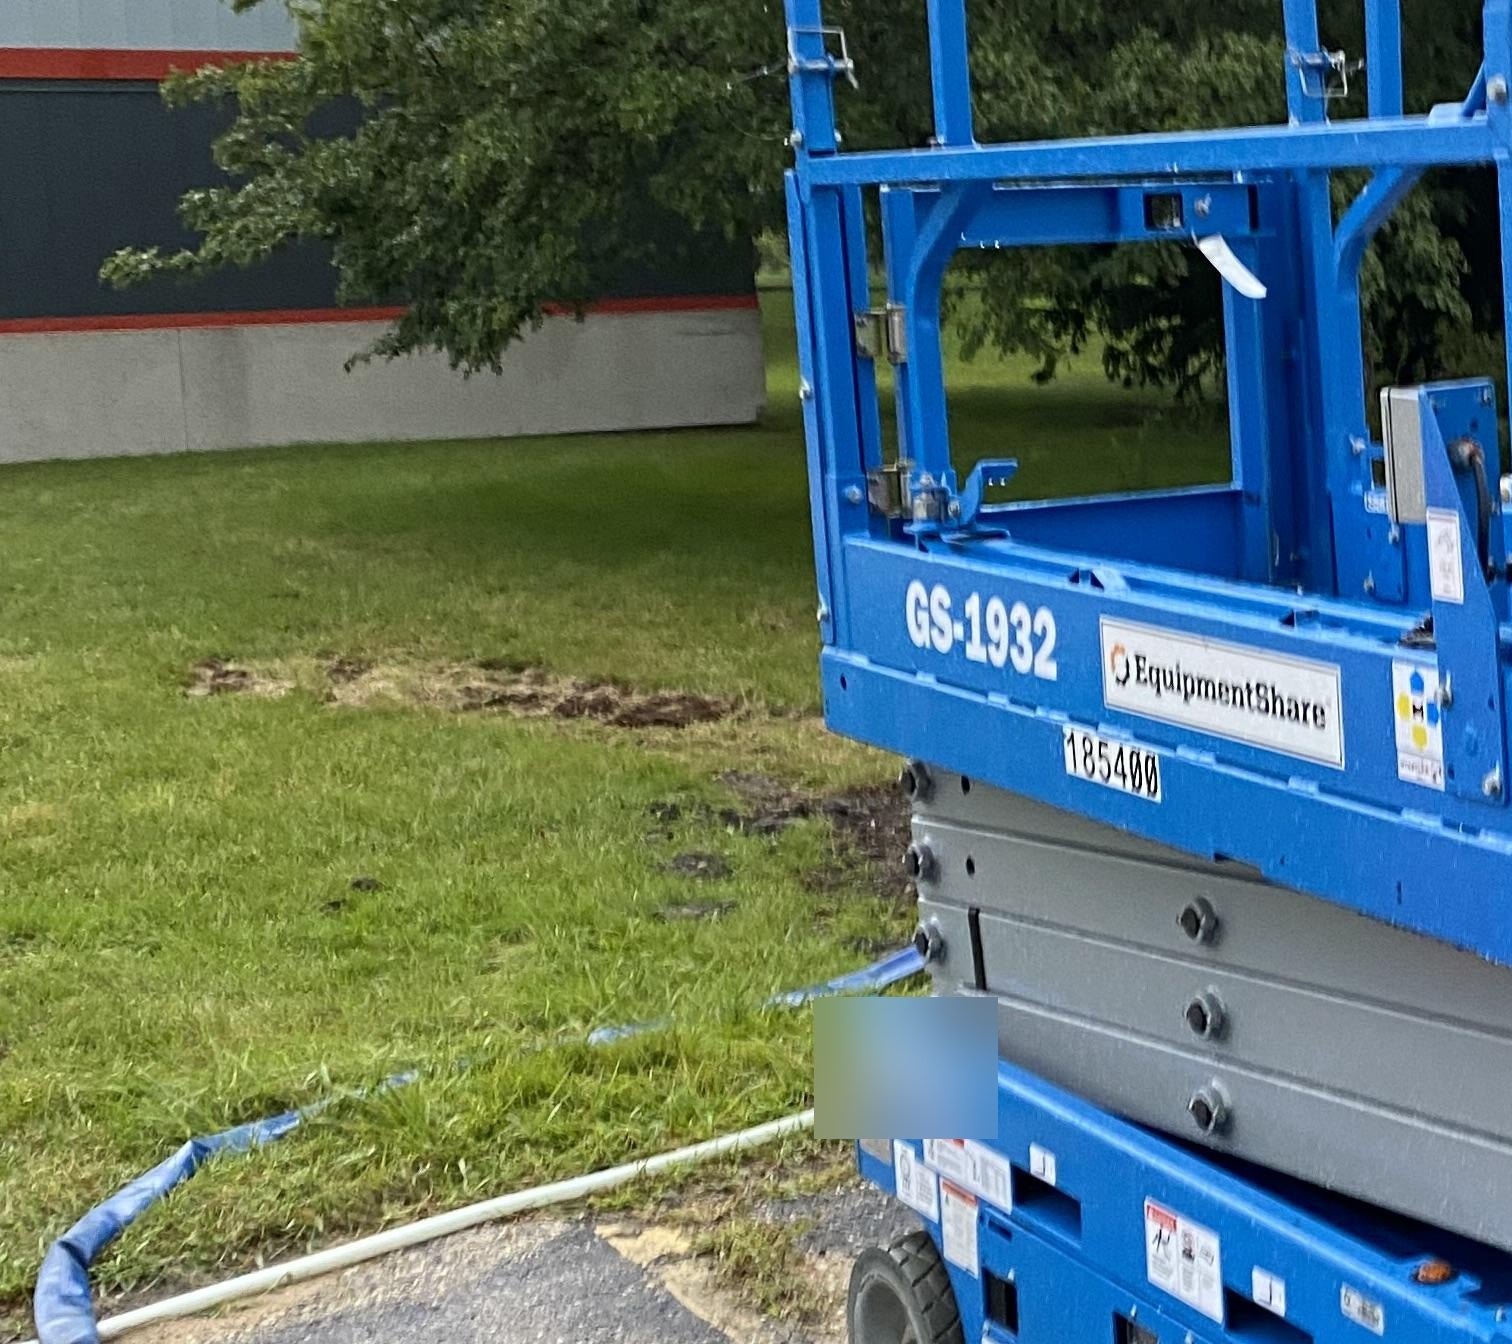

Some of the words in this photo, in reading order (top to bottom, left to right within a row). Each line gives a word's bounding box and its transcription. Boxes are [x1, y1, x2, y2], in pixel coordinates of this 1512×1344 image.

[905, 579, 1058, 681] GS-1932
[1134, 654, 1327, 730] EquipmentShare
[1066, 731, 1160, 799] 185400
